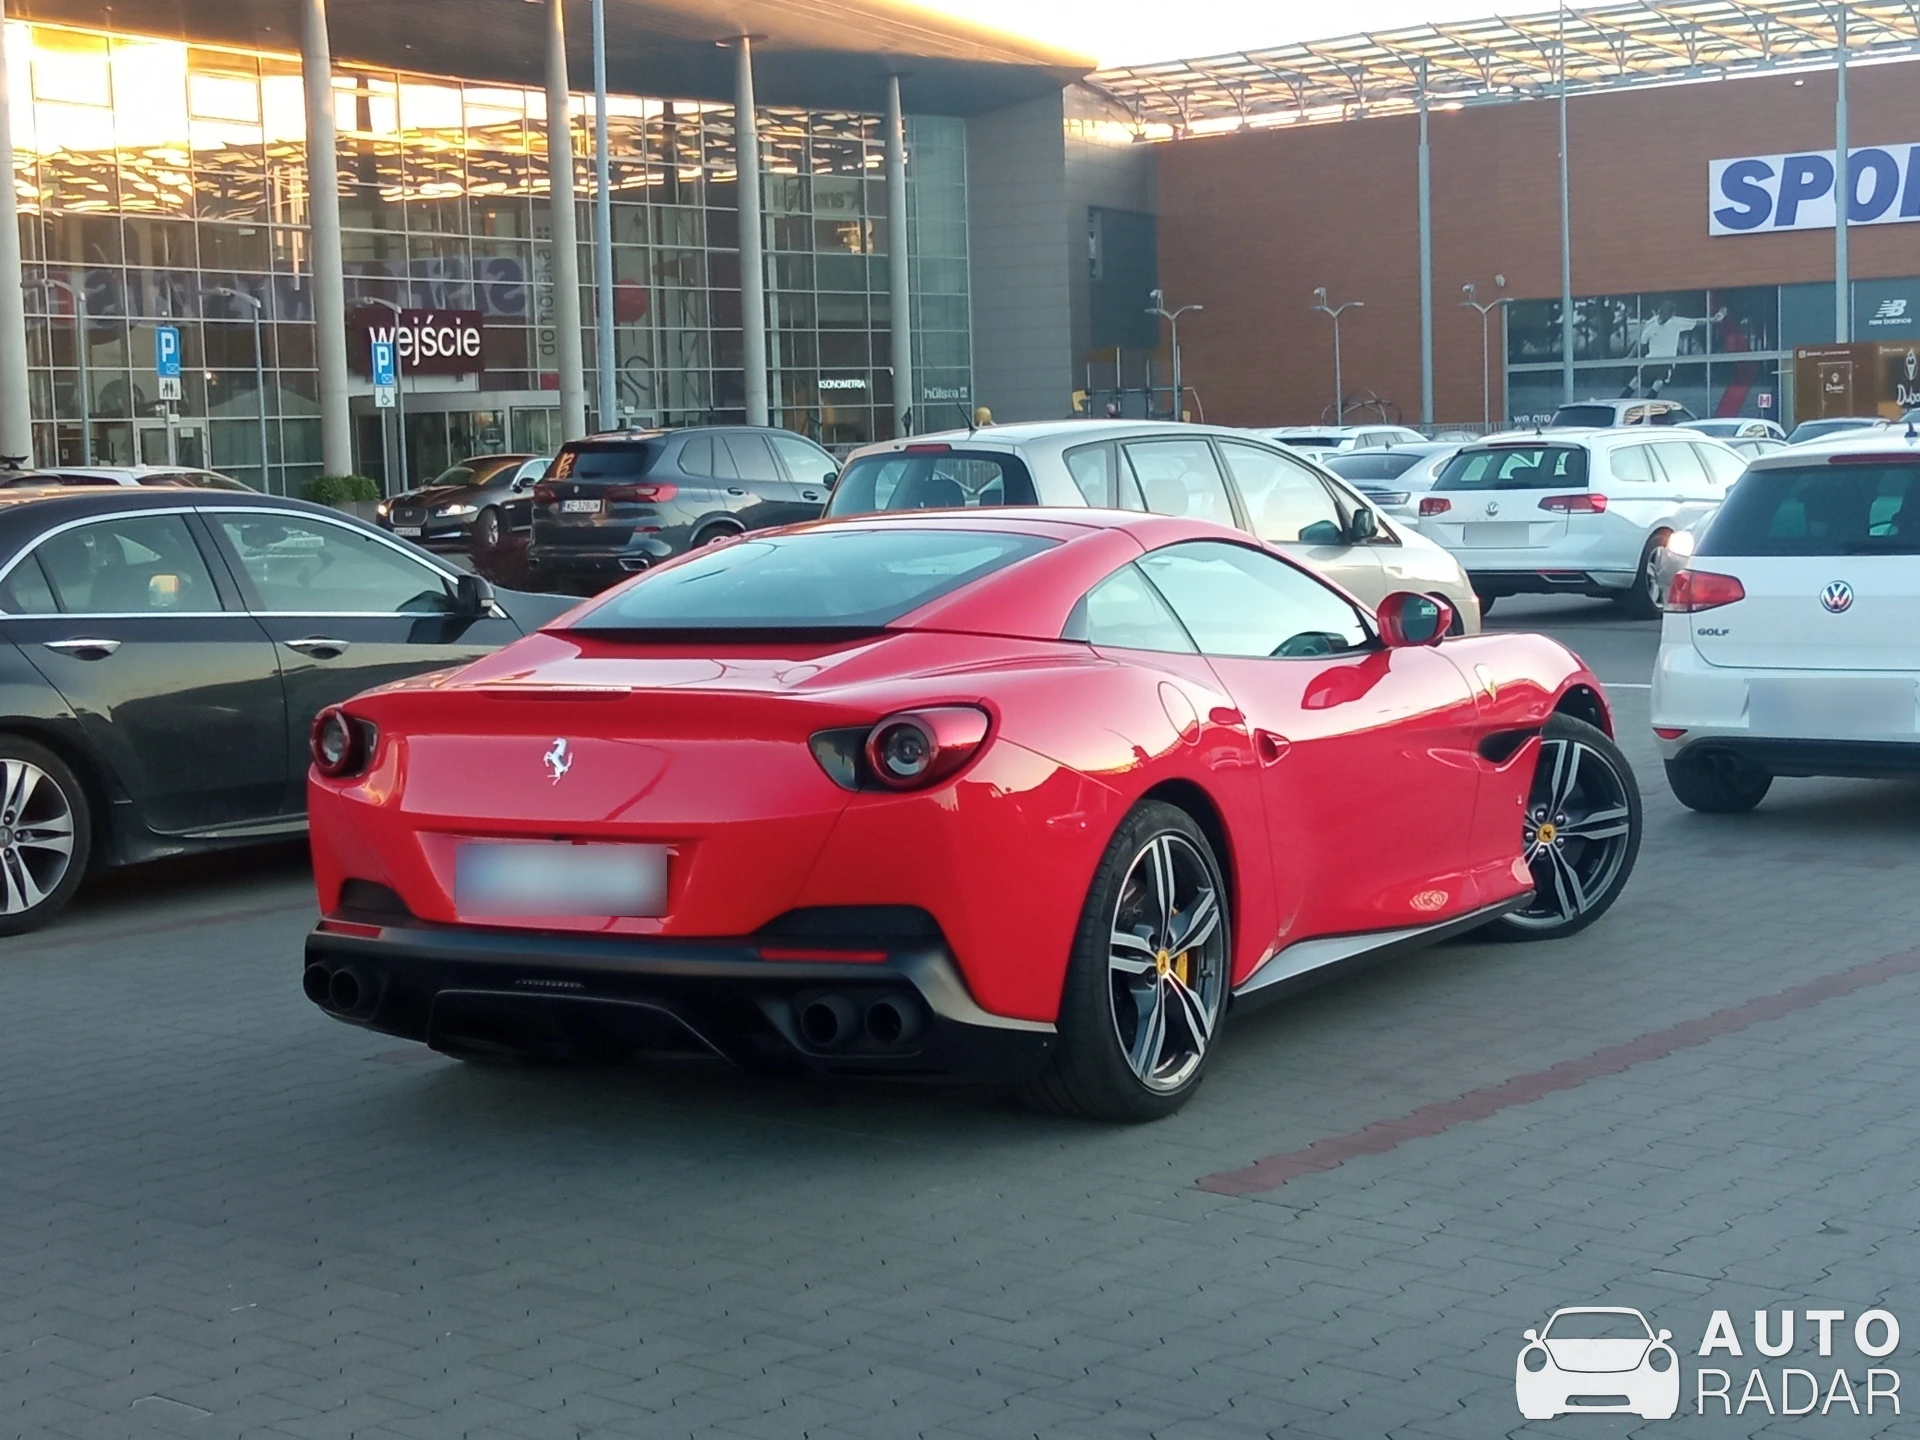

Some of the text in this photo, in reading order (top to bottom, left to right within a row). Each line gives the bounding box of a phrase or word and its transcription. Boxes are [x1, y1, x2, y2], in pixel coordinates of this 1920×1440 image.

[160, 331, 175, 363] P
[368, 314, 481, 366] wejście
[376, 345, 389, 374] P
[1513, 414, 1551, 423] we are
[1697, 628, 1730, 637] GOLF
